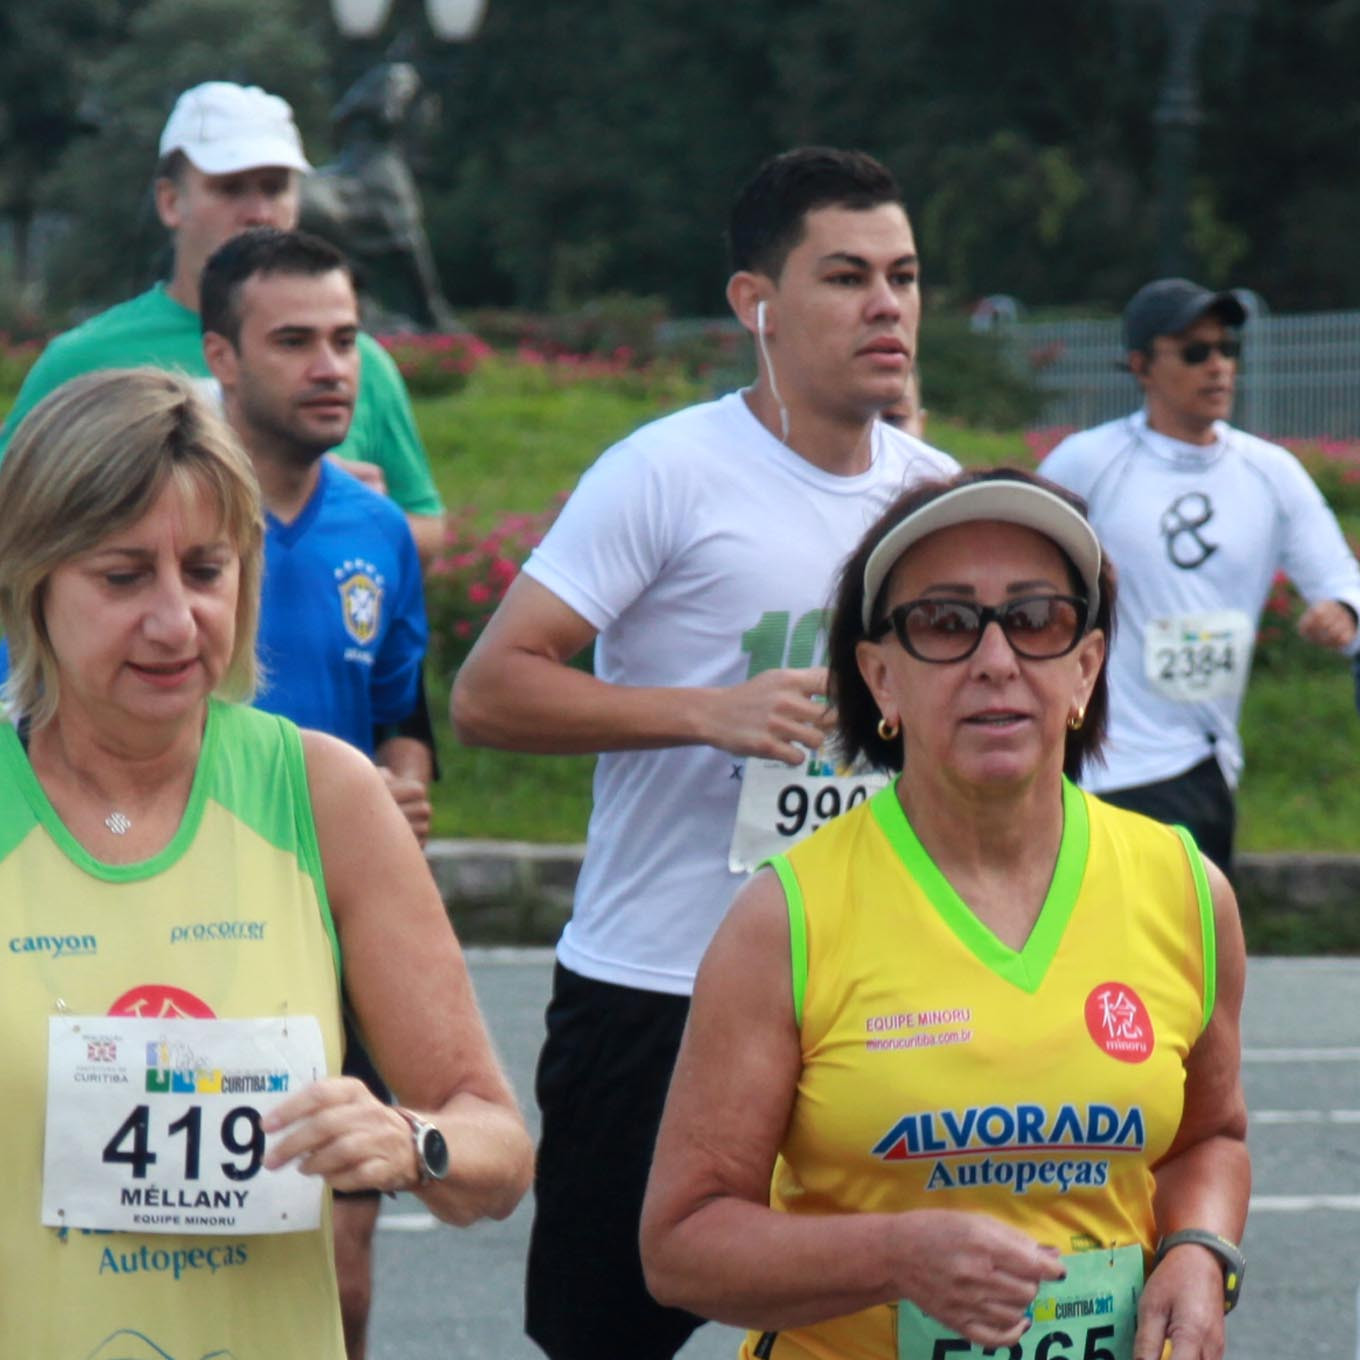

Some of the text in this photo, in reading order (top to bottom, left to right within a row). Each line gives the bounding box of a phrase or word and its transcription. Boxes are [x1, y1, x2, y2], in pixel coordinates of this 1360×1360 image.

[170, 920, 267, 944] procorrer
[9, 935, 97, 957] canyon
[866, 1008, 971, 1033] EQUIPE MINORU
[865, 1029, 972, 1051] minorucuritiba.com.br
[1106, 1038, 1148, 1053] minoru
[74, 1073, 129, 1084] CURITIBA
[220, 1075, 266, 1093] CURITIBA
[871, 1103, 1145, 1156] ALVORADA
[102, 1104, 266, 1182] 419
[926, 1158, 1109, 1194] Autopeças
[120, 1184, 250, 1208] MÉLLANY
[132, 1214, 237, 1227] EQUIPE MINORU
[98, 1244, 249, 1280] Autopeças
[1055, 1301, 1095, 1320] CURITIBA
